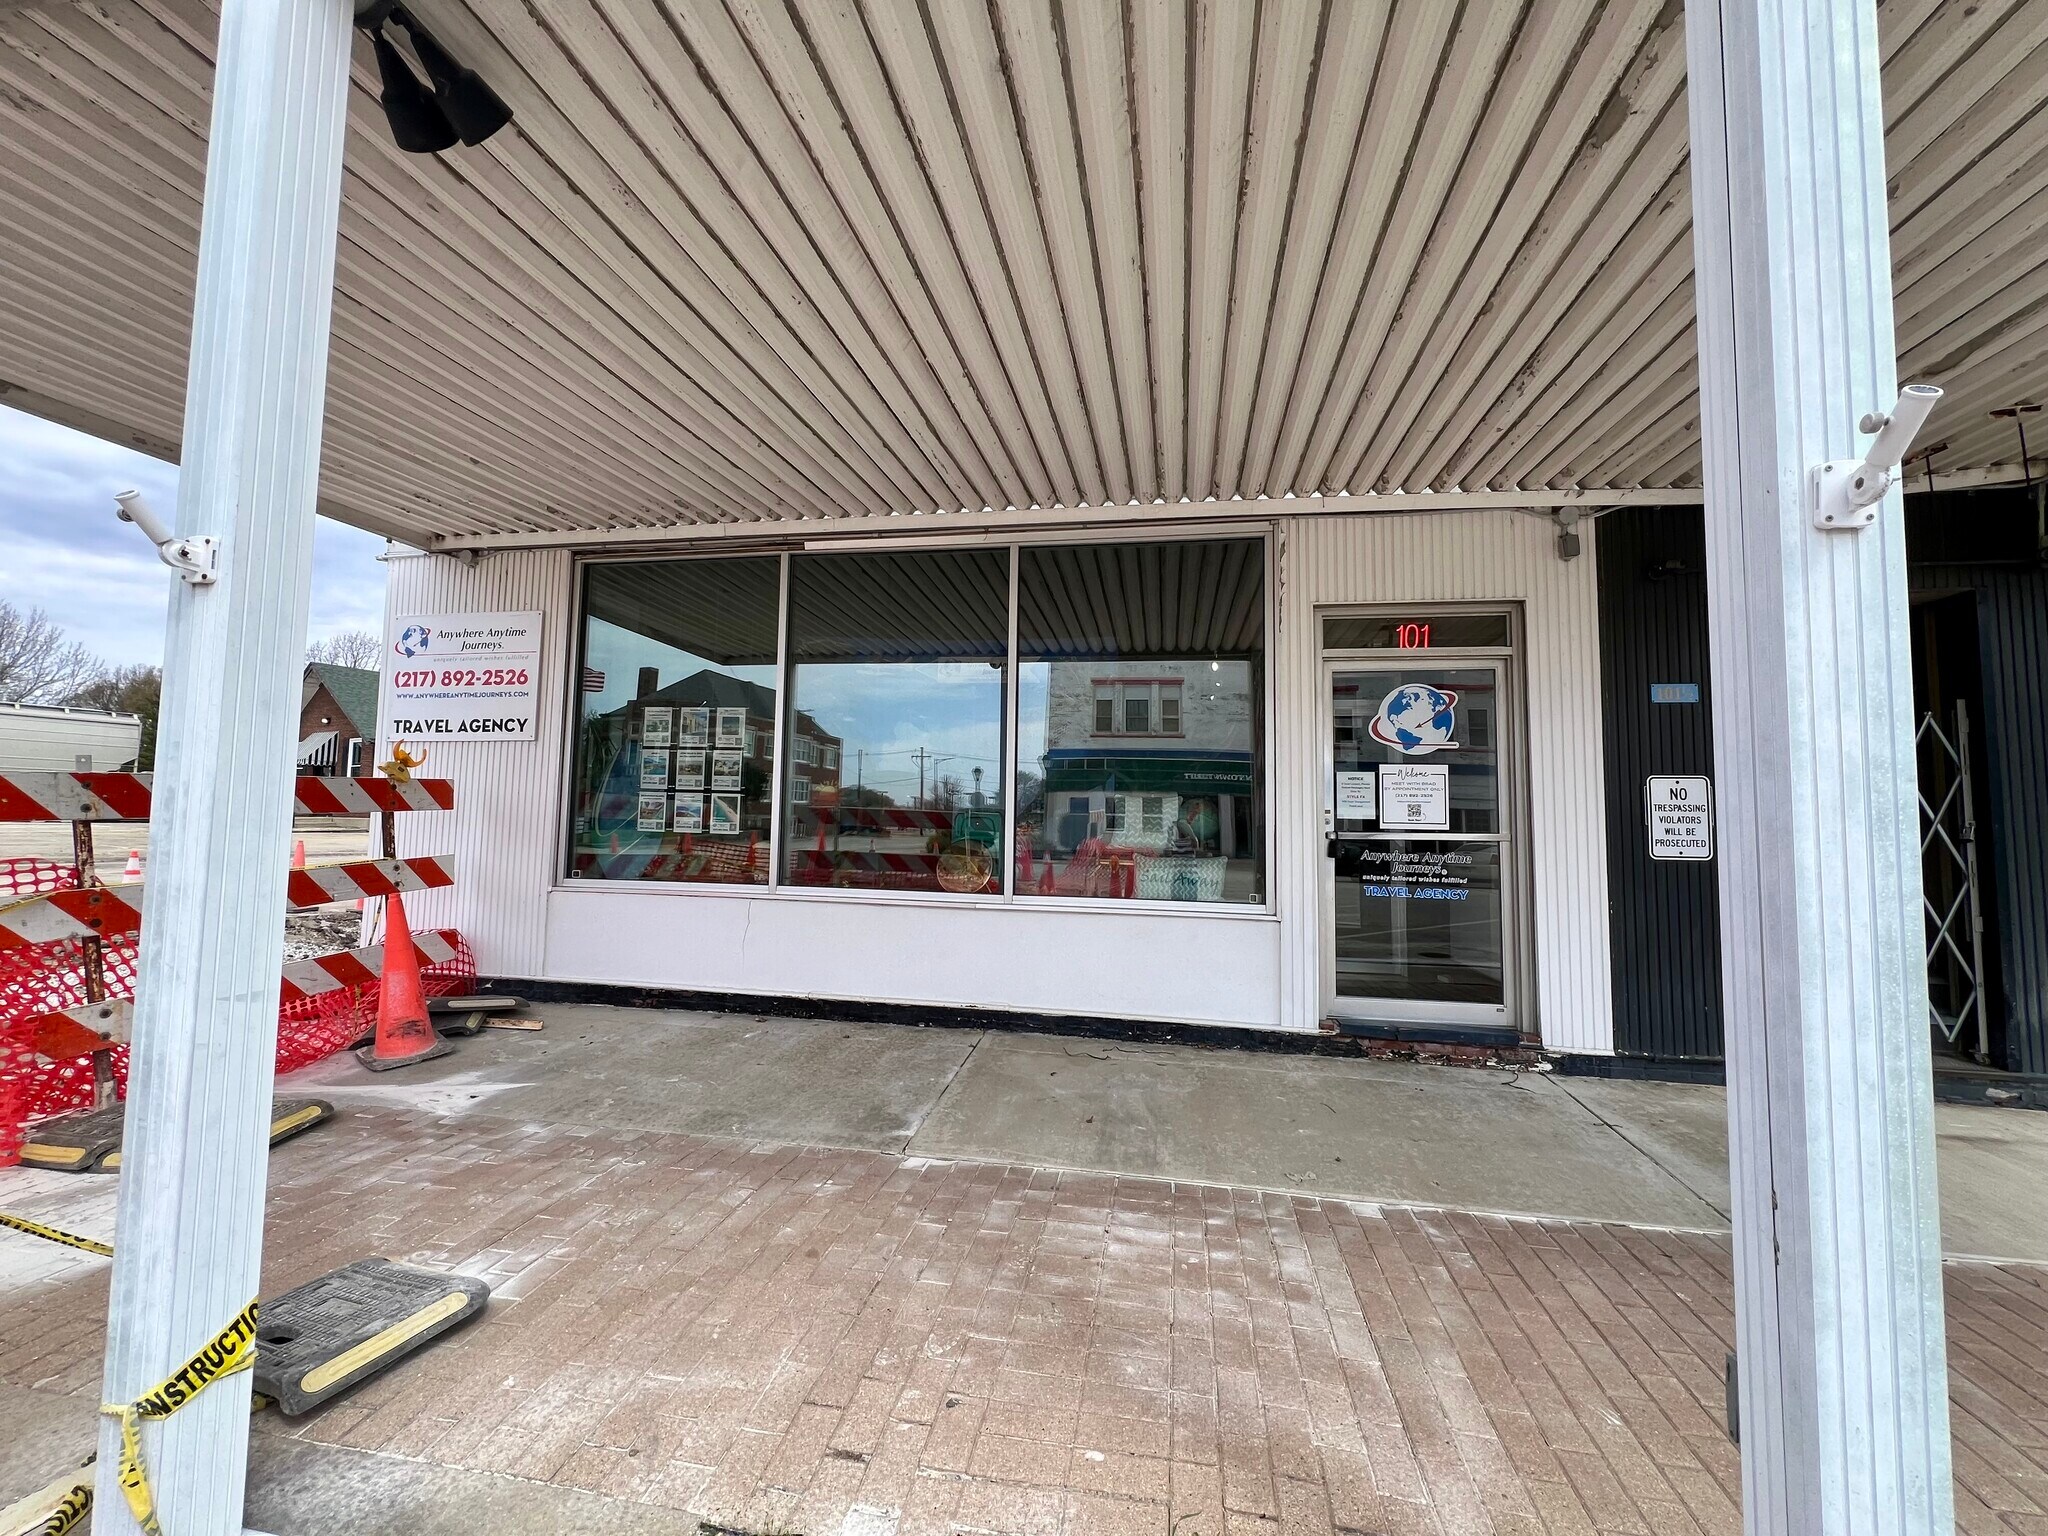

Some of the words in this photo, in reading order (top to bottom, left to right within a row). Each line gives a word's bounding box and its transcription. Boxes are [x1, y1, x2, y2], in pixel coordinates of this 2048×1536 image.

[436, 628, 484, 641] Anywhere
[486, 627, 527, 639] Anytime
[1395, 623, 1430, 650] 101
[394, 670, 436, 689] (217)
[440, 668, 529, 687] 892-2526
[396, 691, 529, 699] WWW.ANYWHEREANYTIMEJOURNEYS.COM
[393, 719, 453, 734] TRAVEL
[457, 718, 528, 733] AGENCY
[1669, 787, 1688, 801] NO
[1653, 803, 1706, 813] TRESPASSING
[1658, 815, 1702, 824] VIOLATORS
[1664, 827, 1682, 836] WILL
[1686, 827, 1696, 836] BE
[1655, 838, 1707, 848] PROSECUTED
[1360, 850, 1419, 864] Anywhere
[1421, 851, 1472, 865] Anytime
[1173, 872, 1220, 896] Away
[1362, 874, 1390, 882] uniquely
[1391, 874, 1417, 882] tailored
[1441, 876, 1468, 884] fulfilled
[1363, 885, 1411, 898] TRAVEL
[1413, 887, 1469, 900] AGENCY
[137, 1302, 258, 1416] NSTRUCTIO
